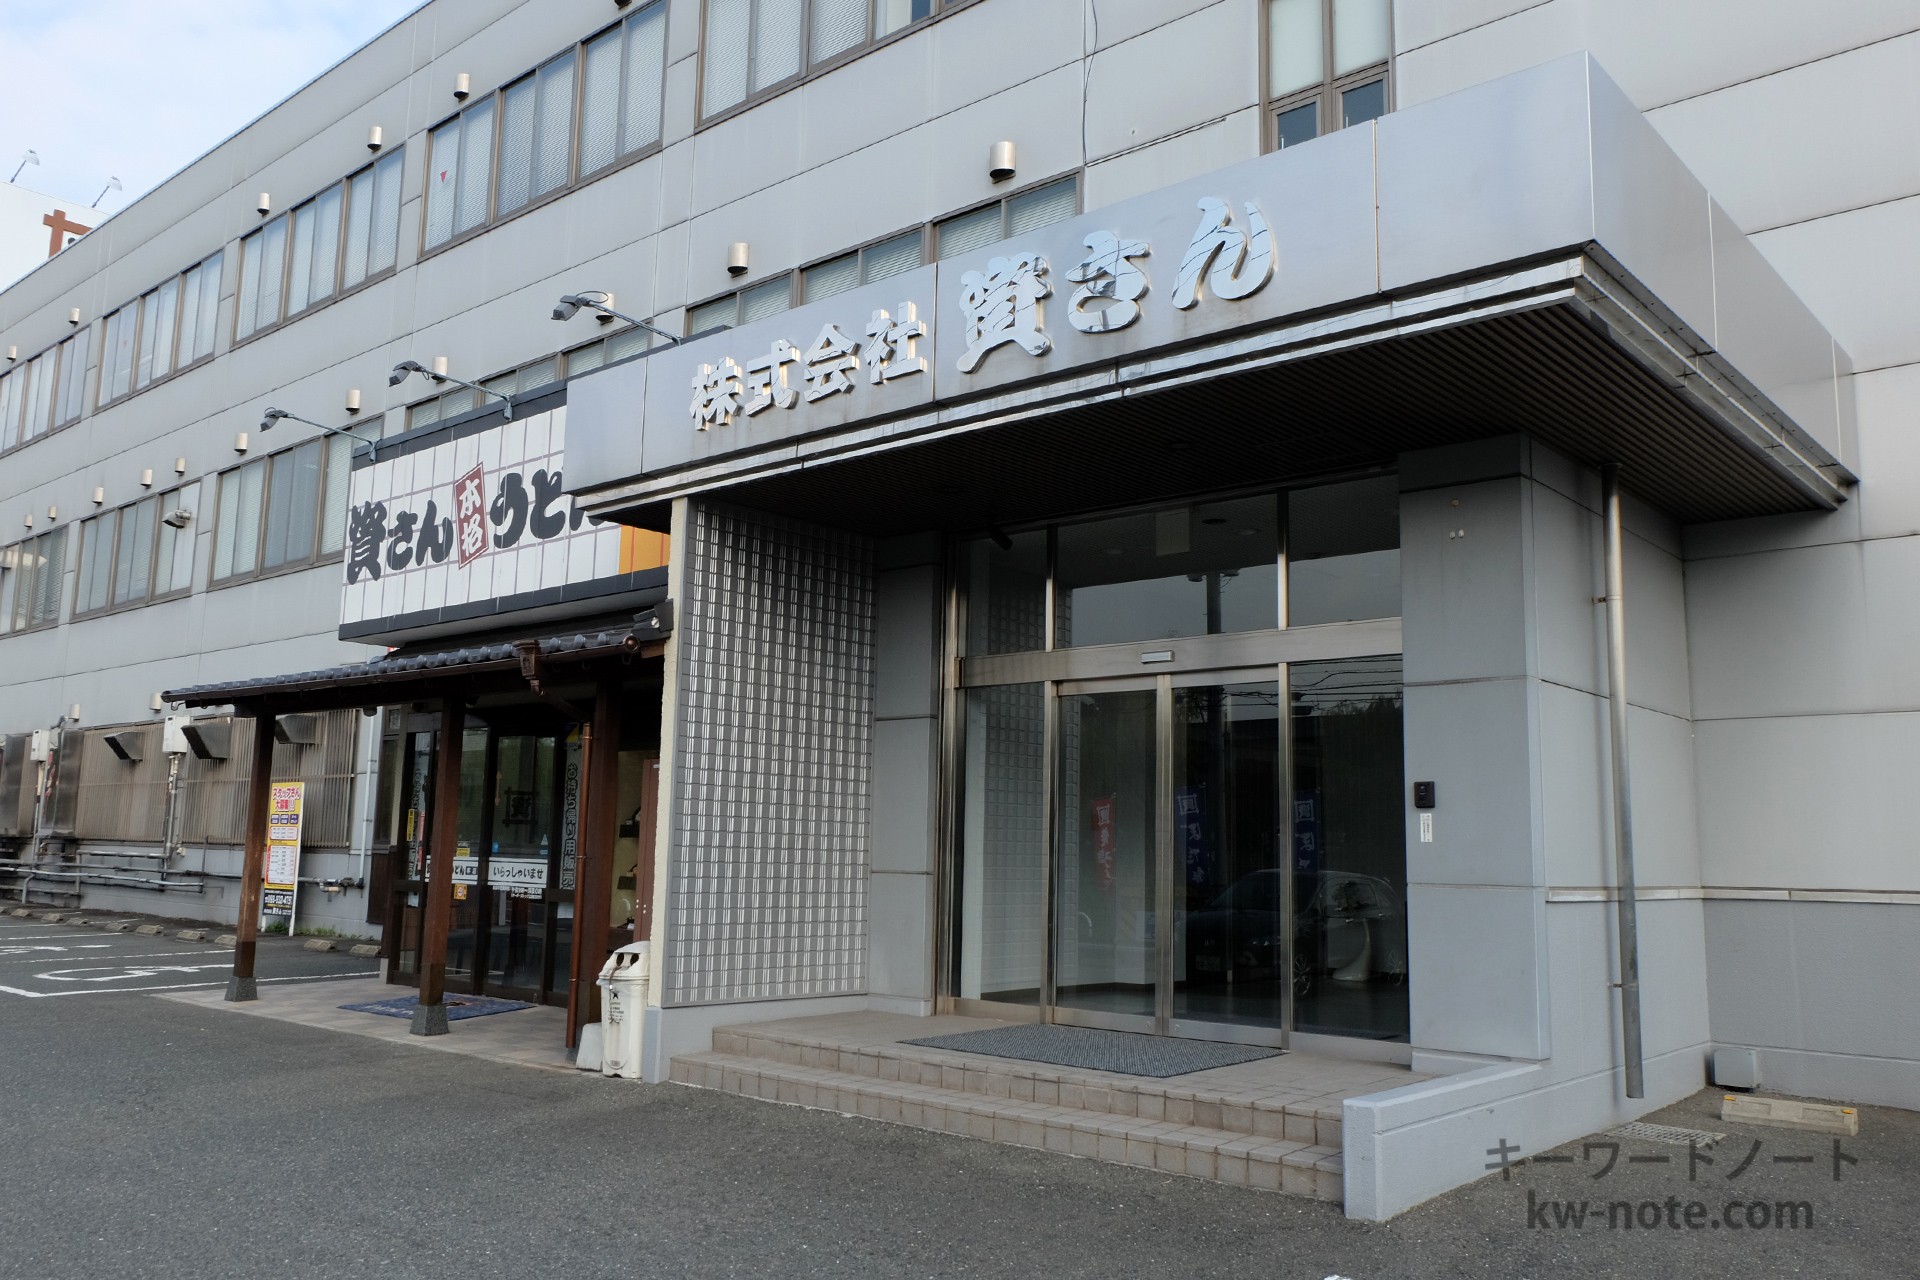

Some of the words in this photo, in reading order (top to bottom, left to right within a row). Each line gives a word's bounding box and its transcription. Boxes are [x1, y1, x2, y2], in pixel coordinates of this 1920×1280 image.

[690, 301, 926, 431] 株式会社
[956, 197, 1276, 375] 資さん
[347, 499, 454, 585] 資さん
[459, 478, 484, 558] 本格
[490, 468, 605, 549] うど
[493, 866, 544, 880] いらっしゃいませ
